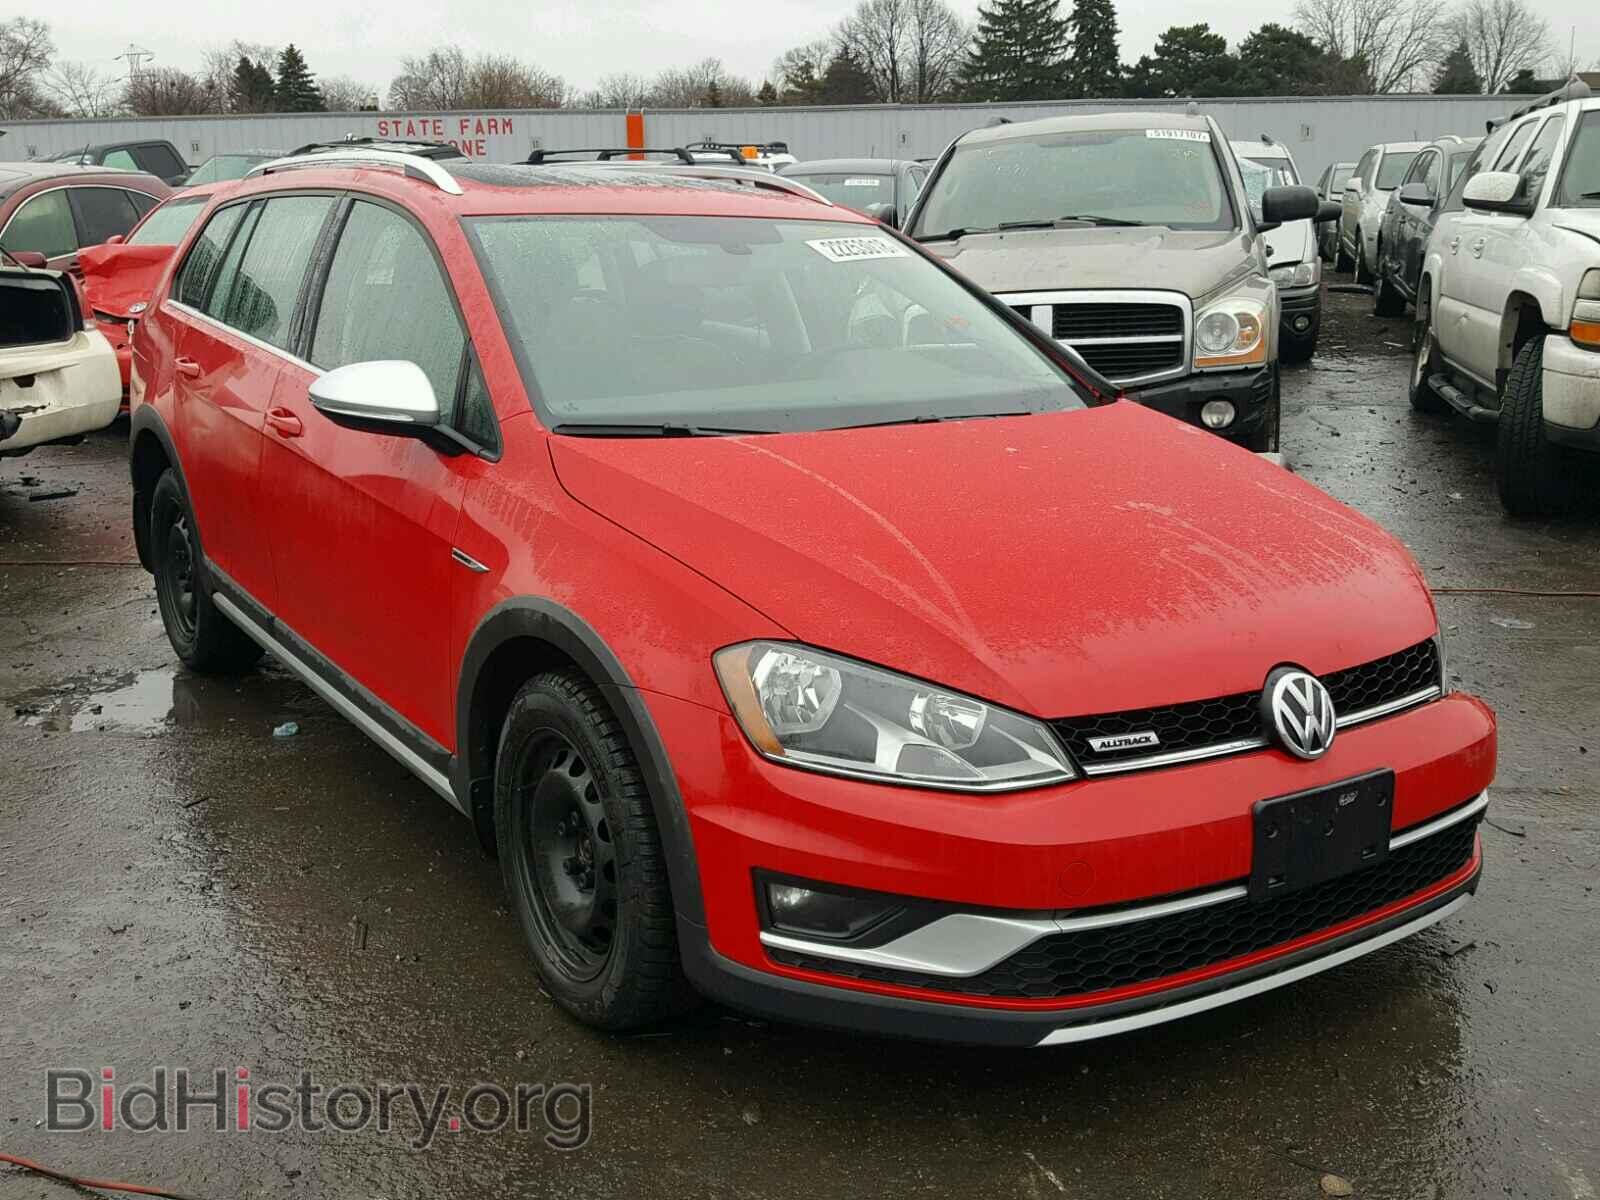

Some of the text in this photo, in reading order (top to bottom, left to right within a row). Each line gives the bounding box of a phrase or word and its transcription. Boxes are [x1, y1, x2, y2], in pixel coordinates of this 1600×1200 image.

[378, 118, 513, 137] STATE FARM
[1273, 672, 1336, 755] VW
[1099, 735, 1153, 749] ALLTRACK
